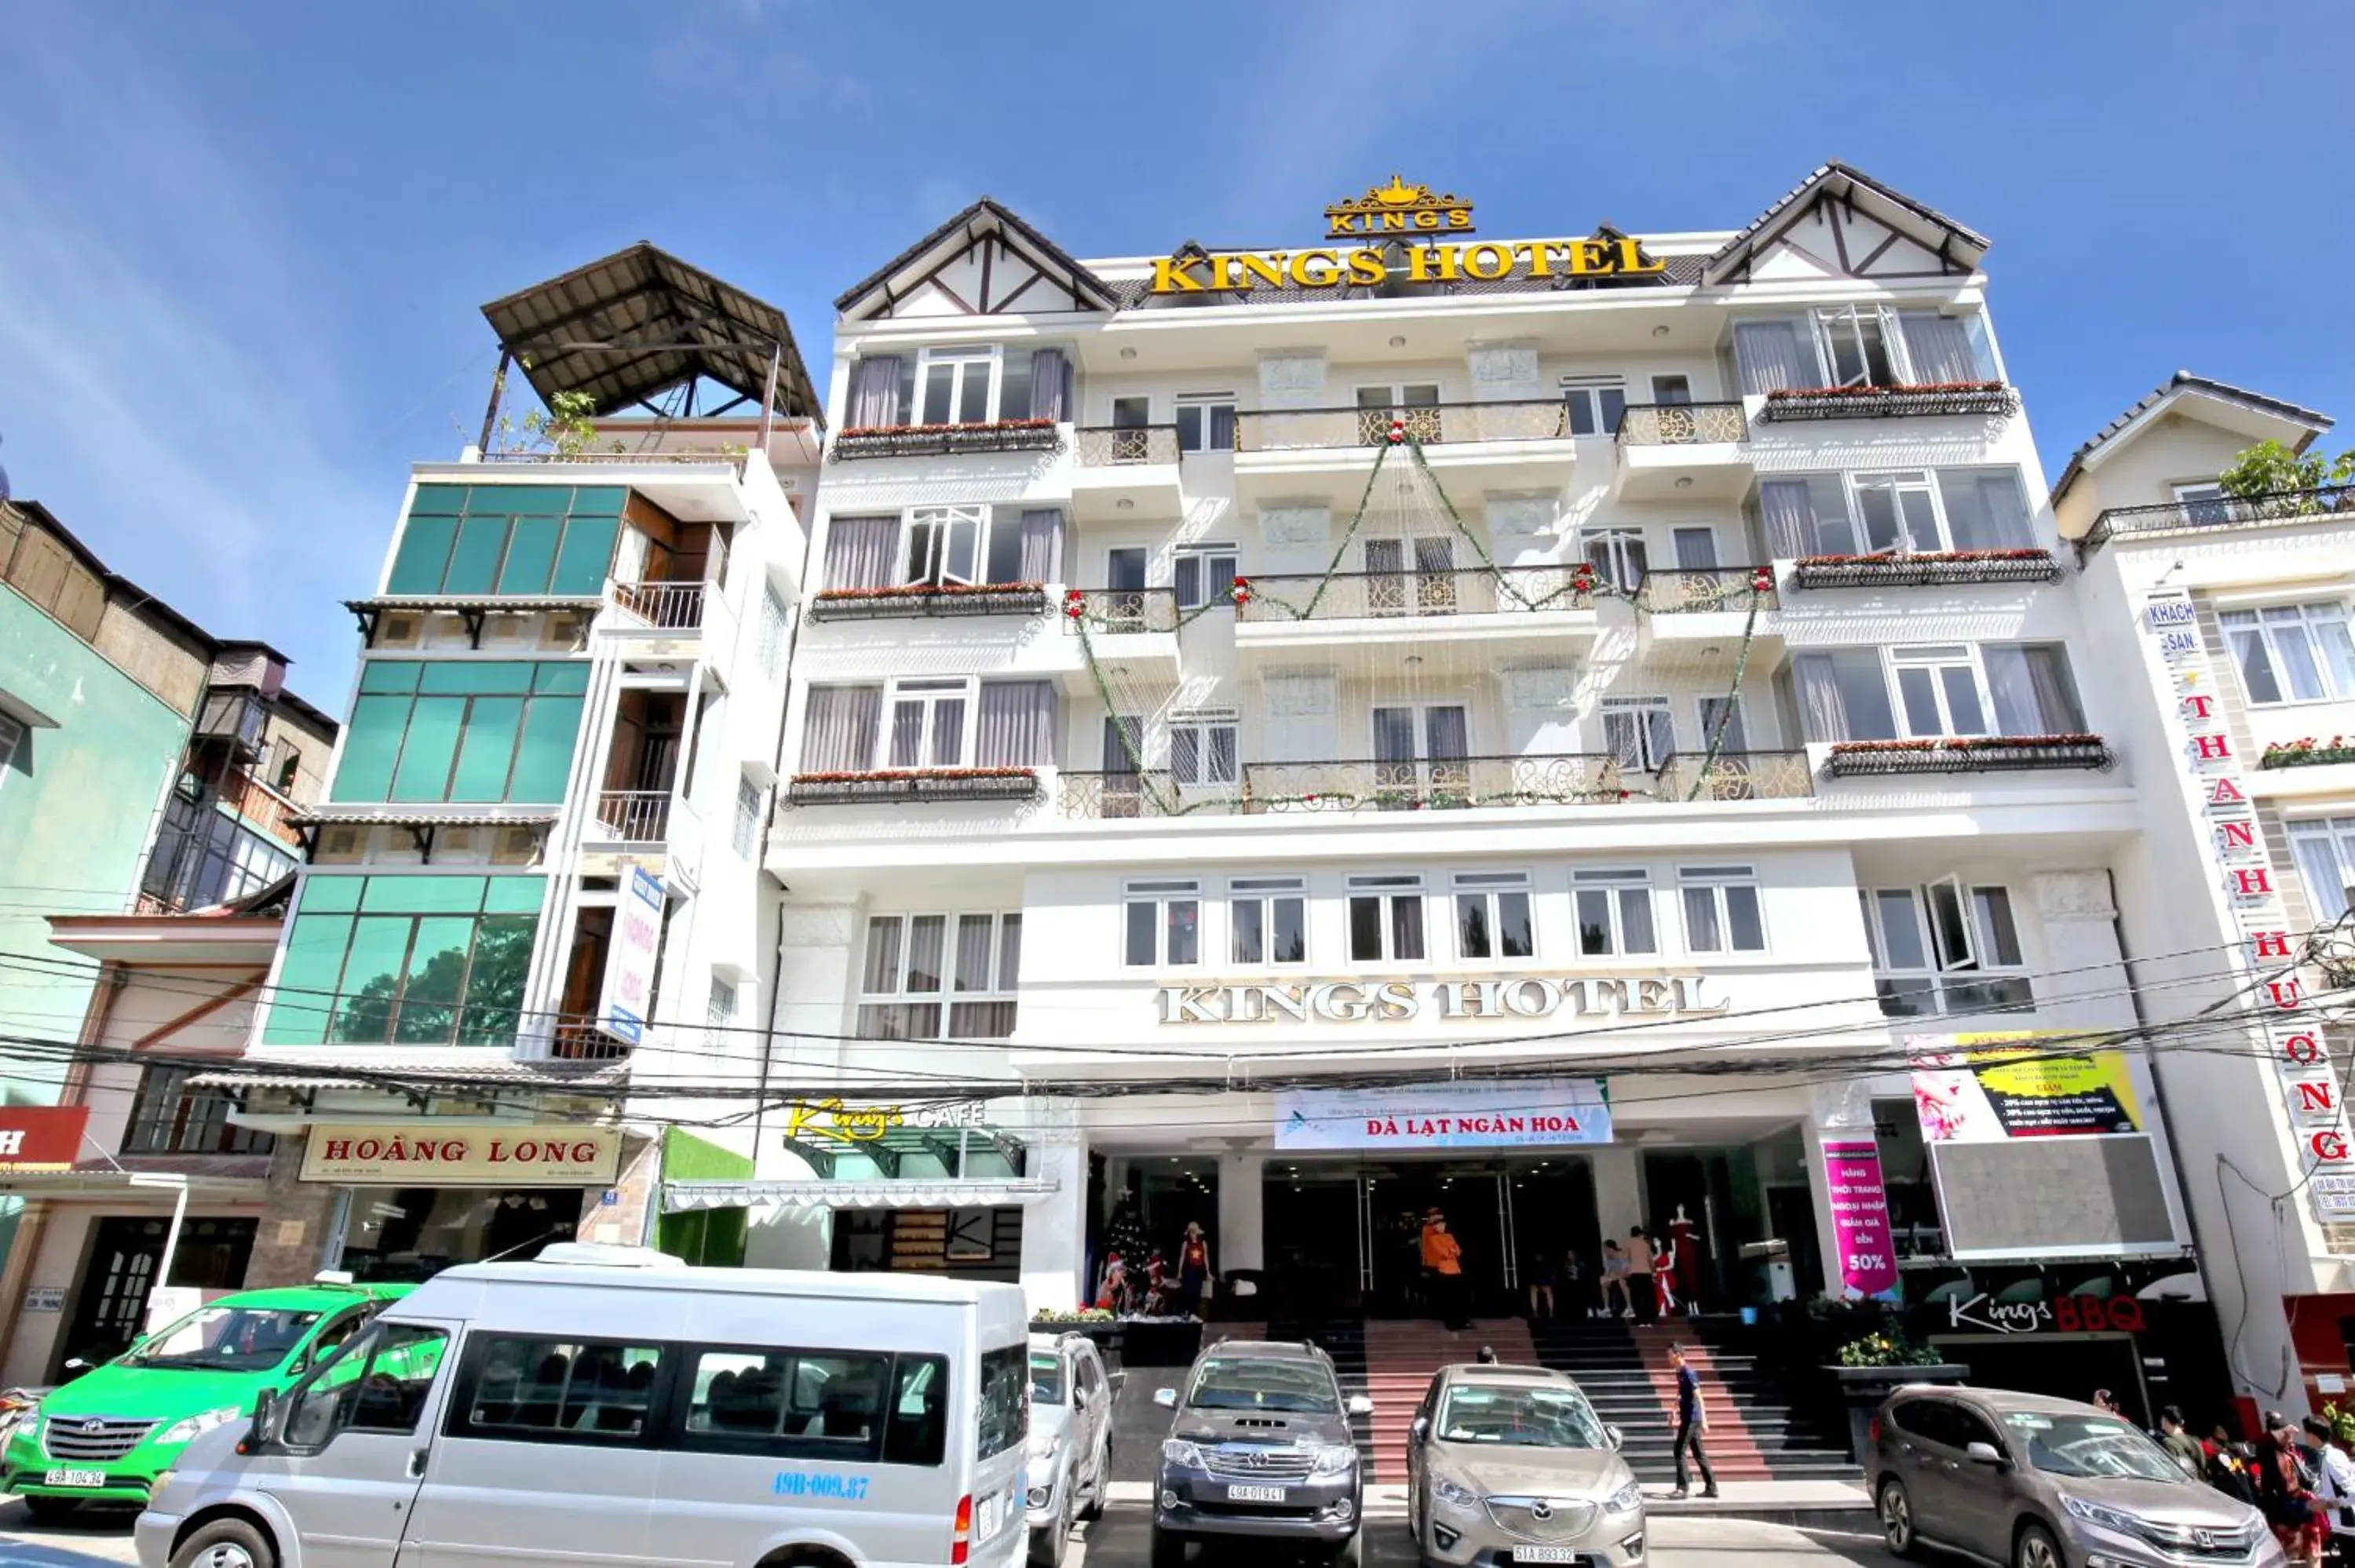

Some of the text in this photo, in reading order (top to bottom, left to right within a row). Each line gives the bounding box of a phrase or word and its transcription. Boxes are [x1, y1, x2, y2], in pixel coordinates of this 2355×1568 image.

[1331, 210, 1471, 233] KINGS
[1151, 238, 1665, 294] KINGS HOTEL
[1158, 975, 1730, 1023] KINGS HOTEL
[1406, 1118, 1452, 1138] LẠT
[1531, 1115, 1580, 1132] HOA
[323, 1135, 598, 1162] HOÀNG LONG
[1849, 1254, 1886, 1271] 50%
[1949, 1293, 2147, 1333] Kings BBQ
